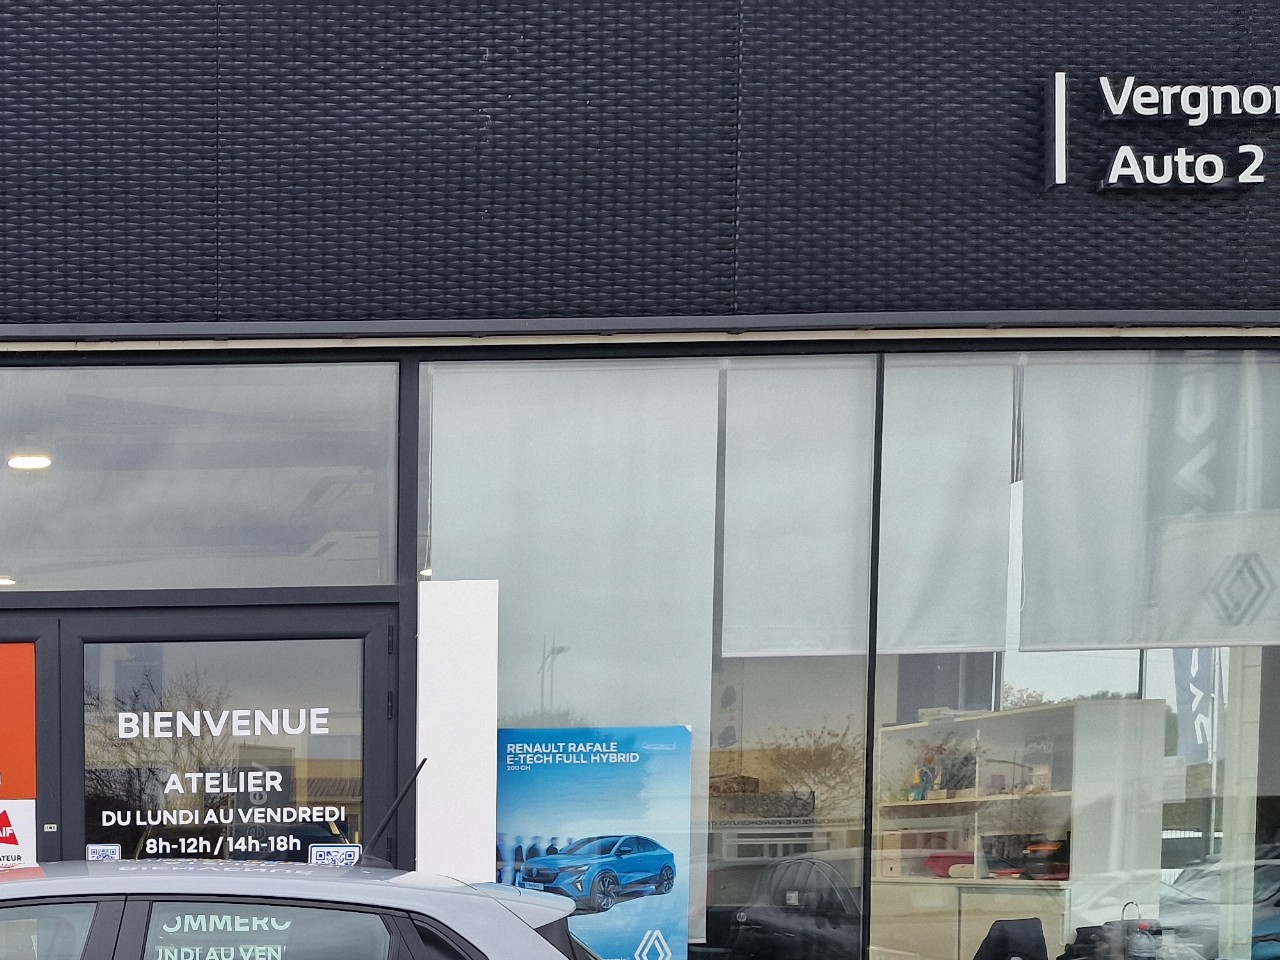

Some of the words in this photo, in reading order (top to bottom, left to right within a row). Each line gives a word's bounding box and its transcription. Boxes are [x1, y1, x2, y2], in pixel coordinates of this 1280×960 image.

[1108, 145, 1224, 184] Auto
[1238, 144, 1265, 183] 2
[118, 707, 329, 739] BIENVENUE
[506, 743, 566, 754] RENAULT
[568, 742, 618, 753] RAFALE
[506, 754, 553, 765] E-TECH
[556, 753, 588, 764] FULL
[590, 752, 640, 763] HYBRID
[163, 771, 283, 794] ATELIER
[101, 810, 132, 827] DU
[135, 809, 199, 826] LUNDI
[203, 808, 234, 825] AU
[238, 806, 346, 824] VENDREDI
[145, 836, 211, 854] 8h-12h
[227, 834, 301, 853] 14h-18h
